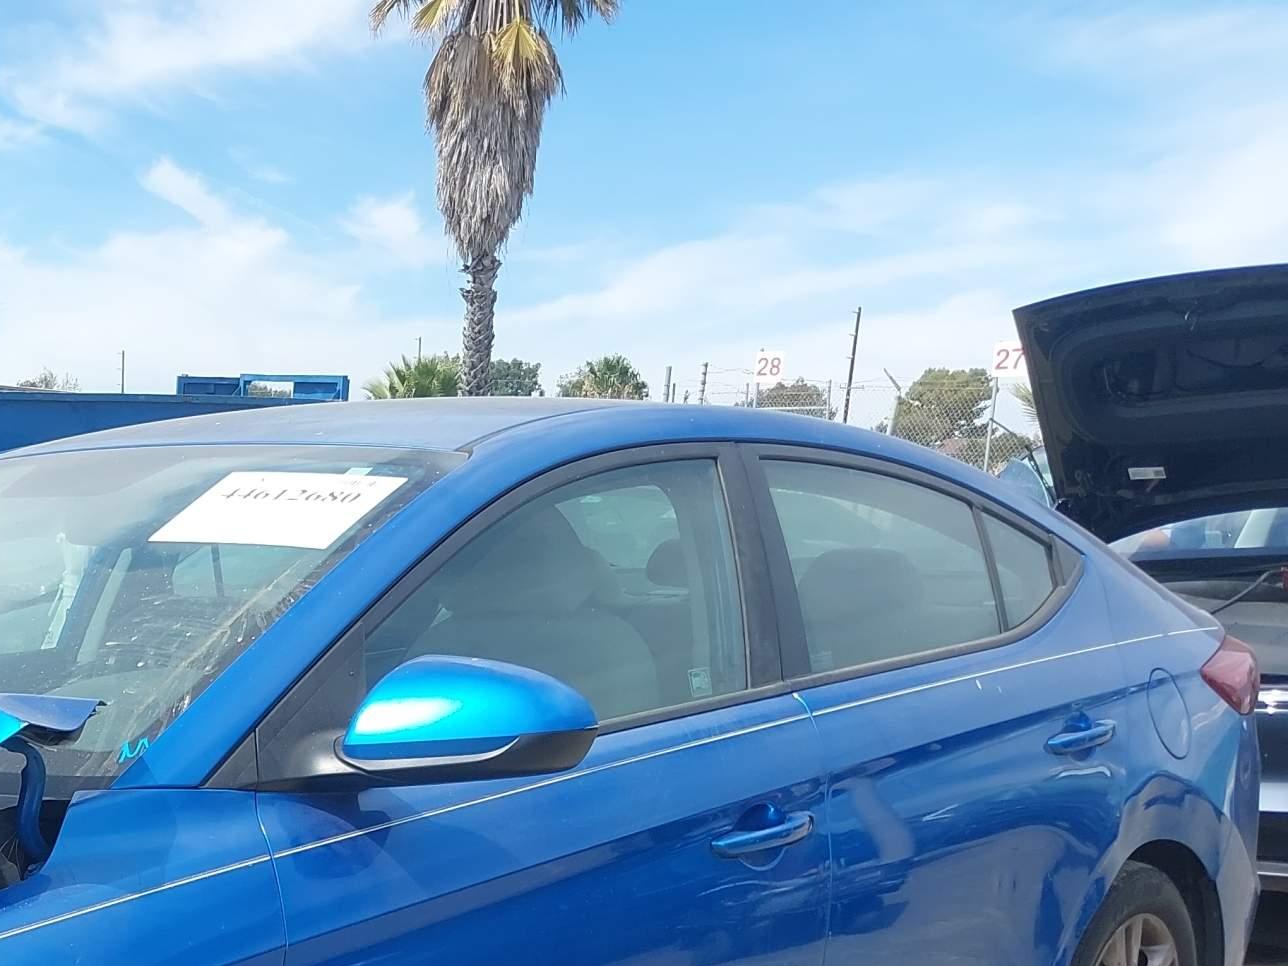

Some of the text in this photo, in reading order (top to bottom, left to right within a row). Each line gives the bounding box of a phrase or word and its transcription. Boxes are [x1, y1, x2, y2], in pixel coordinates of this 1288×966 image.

[757, 357, 782, 377] 28
[995, 348, 1026, 370] 27
[221, 487, 362, 504] 44612680
